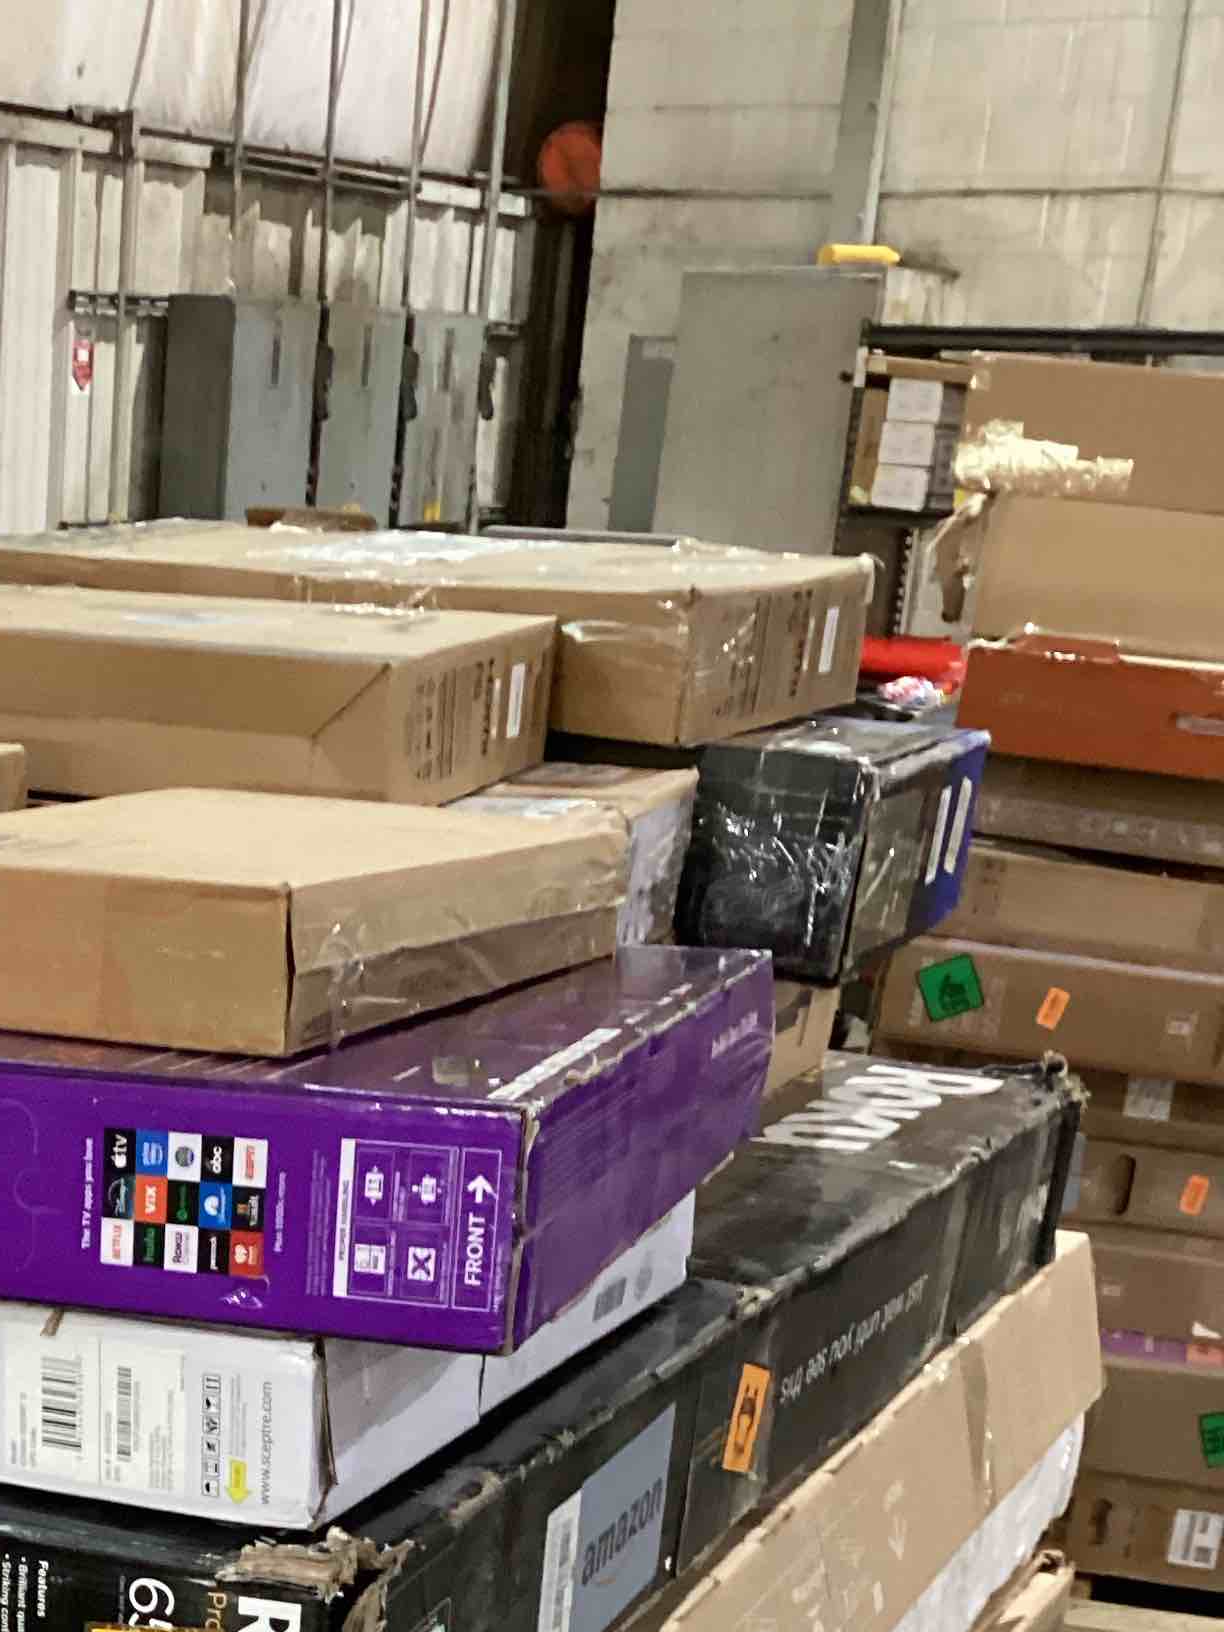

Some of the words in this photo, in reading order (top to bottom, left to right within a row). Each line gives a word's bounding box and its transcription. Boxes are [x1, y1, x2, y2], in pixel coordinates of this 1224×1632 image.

[211, 1145, 224, 1174] abc
[464, 1212, 486, 1287] FRONT
[257, 1381, 273, 1505] www.sceptre.com
[581, 1477, 662, 1587] amazon
[0, 1561, 11, 1605] Striking
[17, 1563, 28, 1608] Brilliant
[36, 1560, 49, 1618] Features
